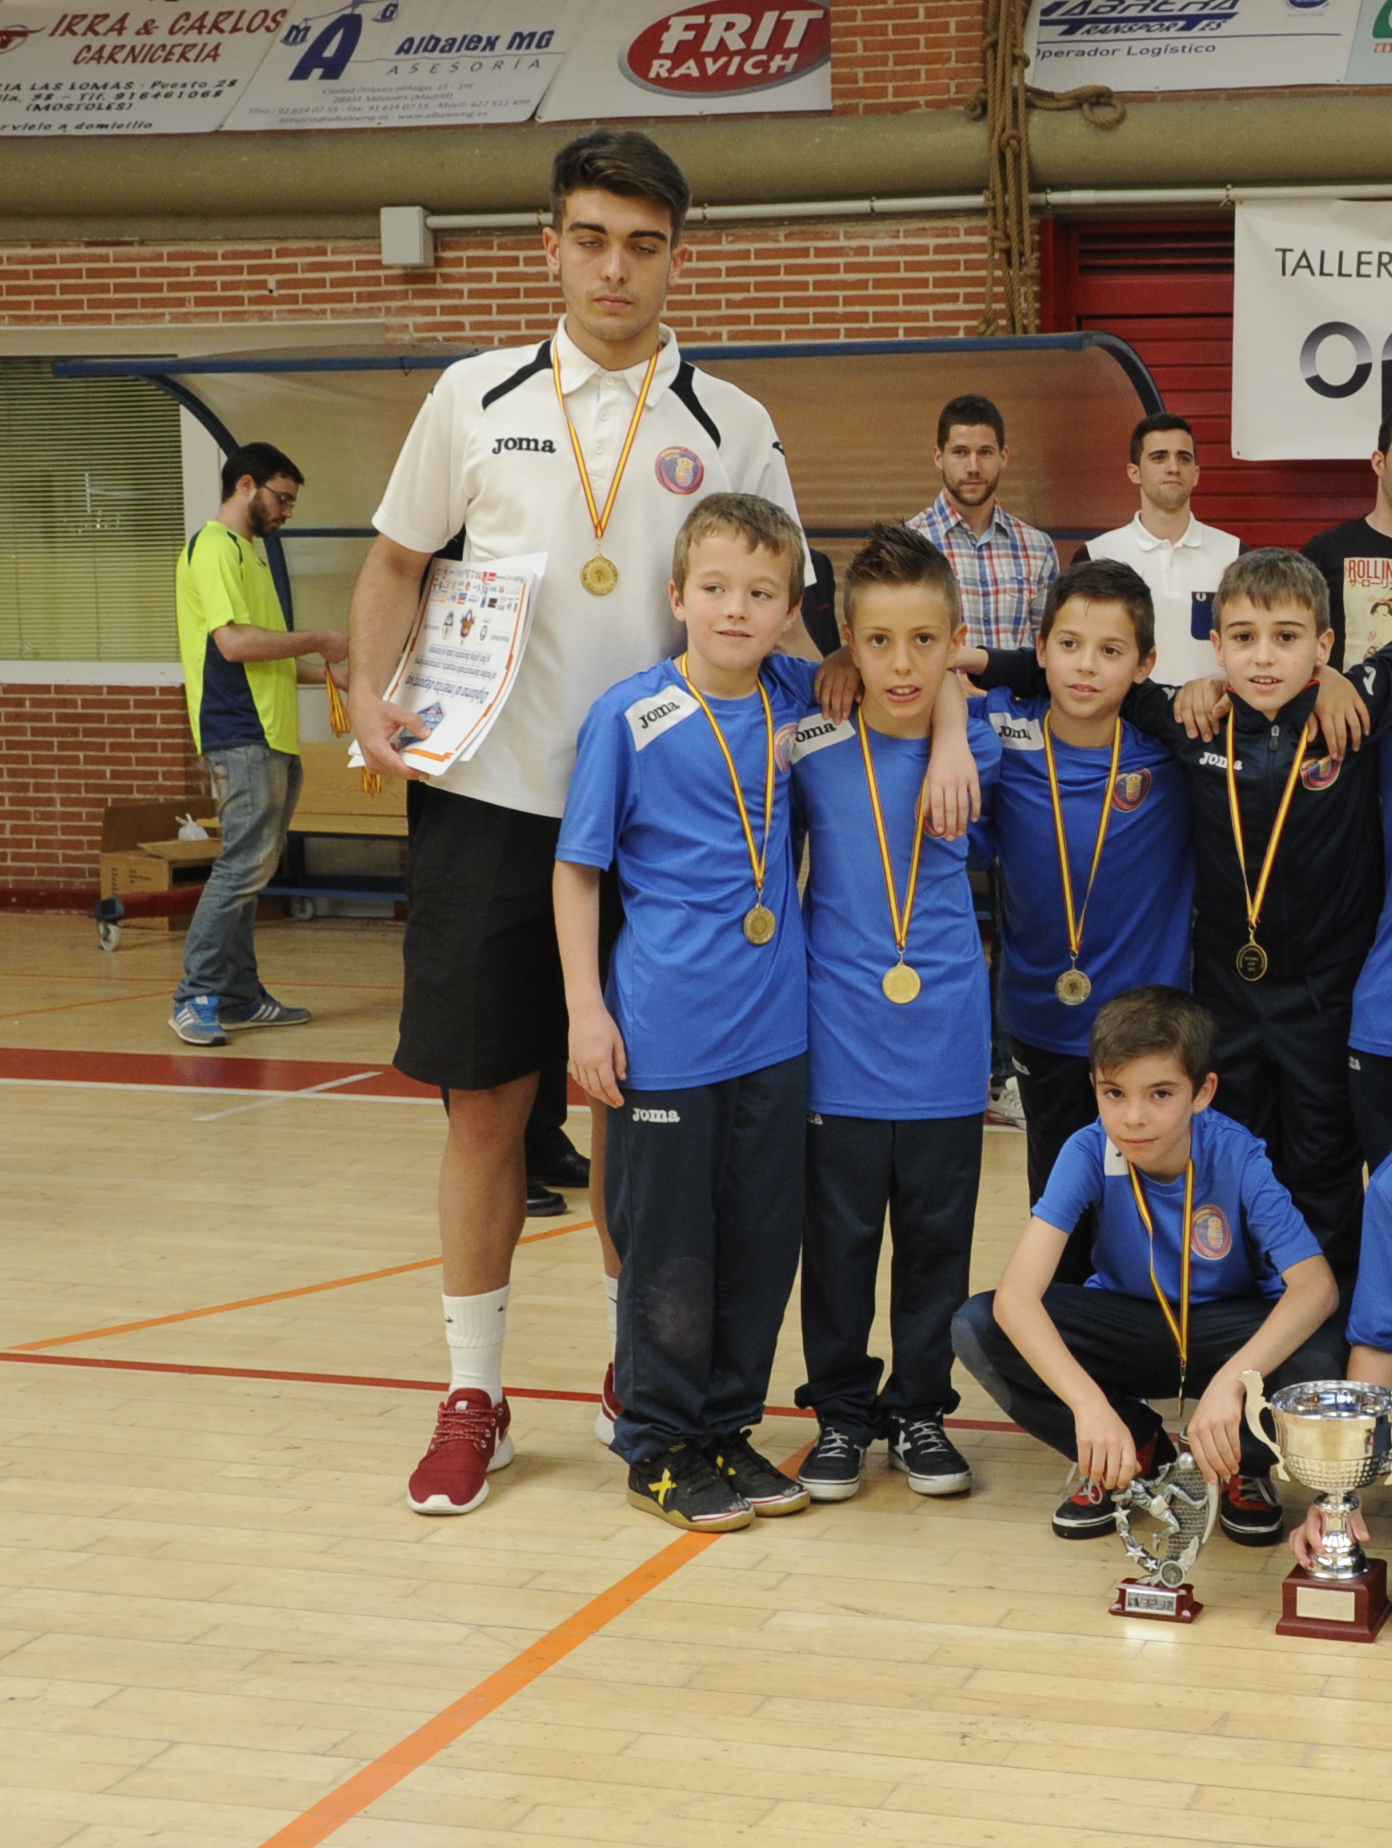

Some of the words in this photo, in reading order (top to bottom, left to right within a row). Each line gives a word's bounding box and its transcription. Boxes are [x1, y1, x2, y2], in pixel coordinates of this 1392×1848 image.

[48, 12, 130, 37] IRRA
[134, 19, 159, 36] &
[167, 9, 288, 35] CARLOS
[659, 10, 825, 54] FRIT
[72, 42, 222, 65] CARNICERIA
[288, 13, 363, 81] A
[394, 34, 501, 56] Albalex
[506, 30, 555, 51] MG
[1126, 43, 1217, 58] Logístico
[648, 53, 799, 78] RAVICH
[30, 82, 63, 91] LAS
[69, 81, 135, 91] LOMAS
[150, 80, 208, 90] Puesto
[25, 102, 133, 112] (MOSTOLES)
[0, 121, 52, 131] rvicio
[74, 119, 153, 131] domicilio
[796, 722, 837, 743] oma
